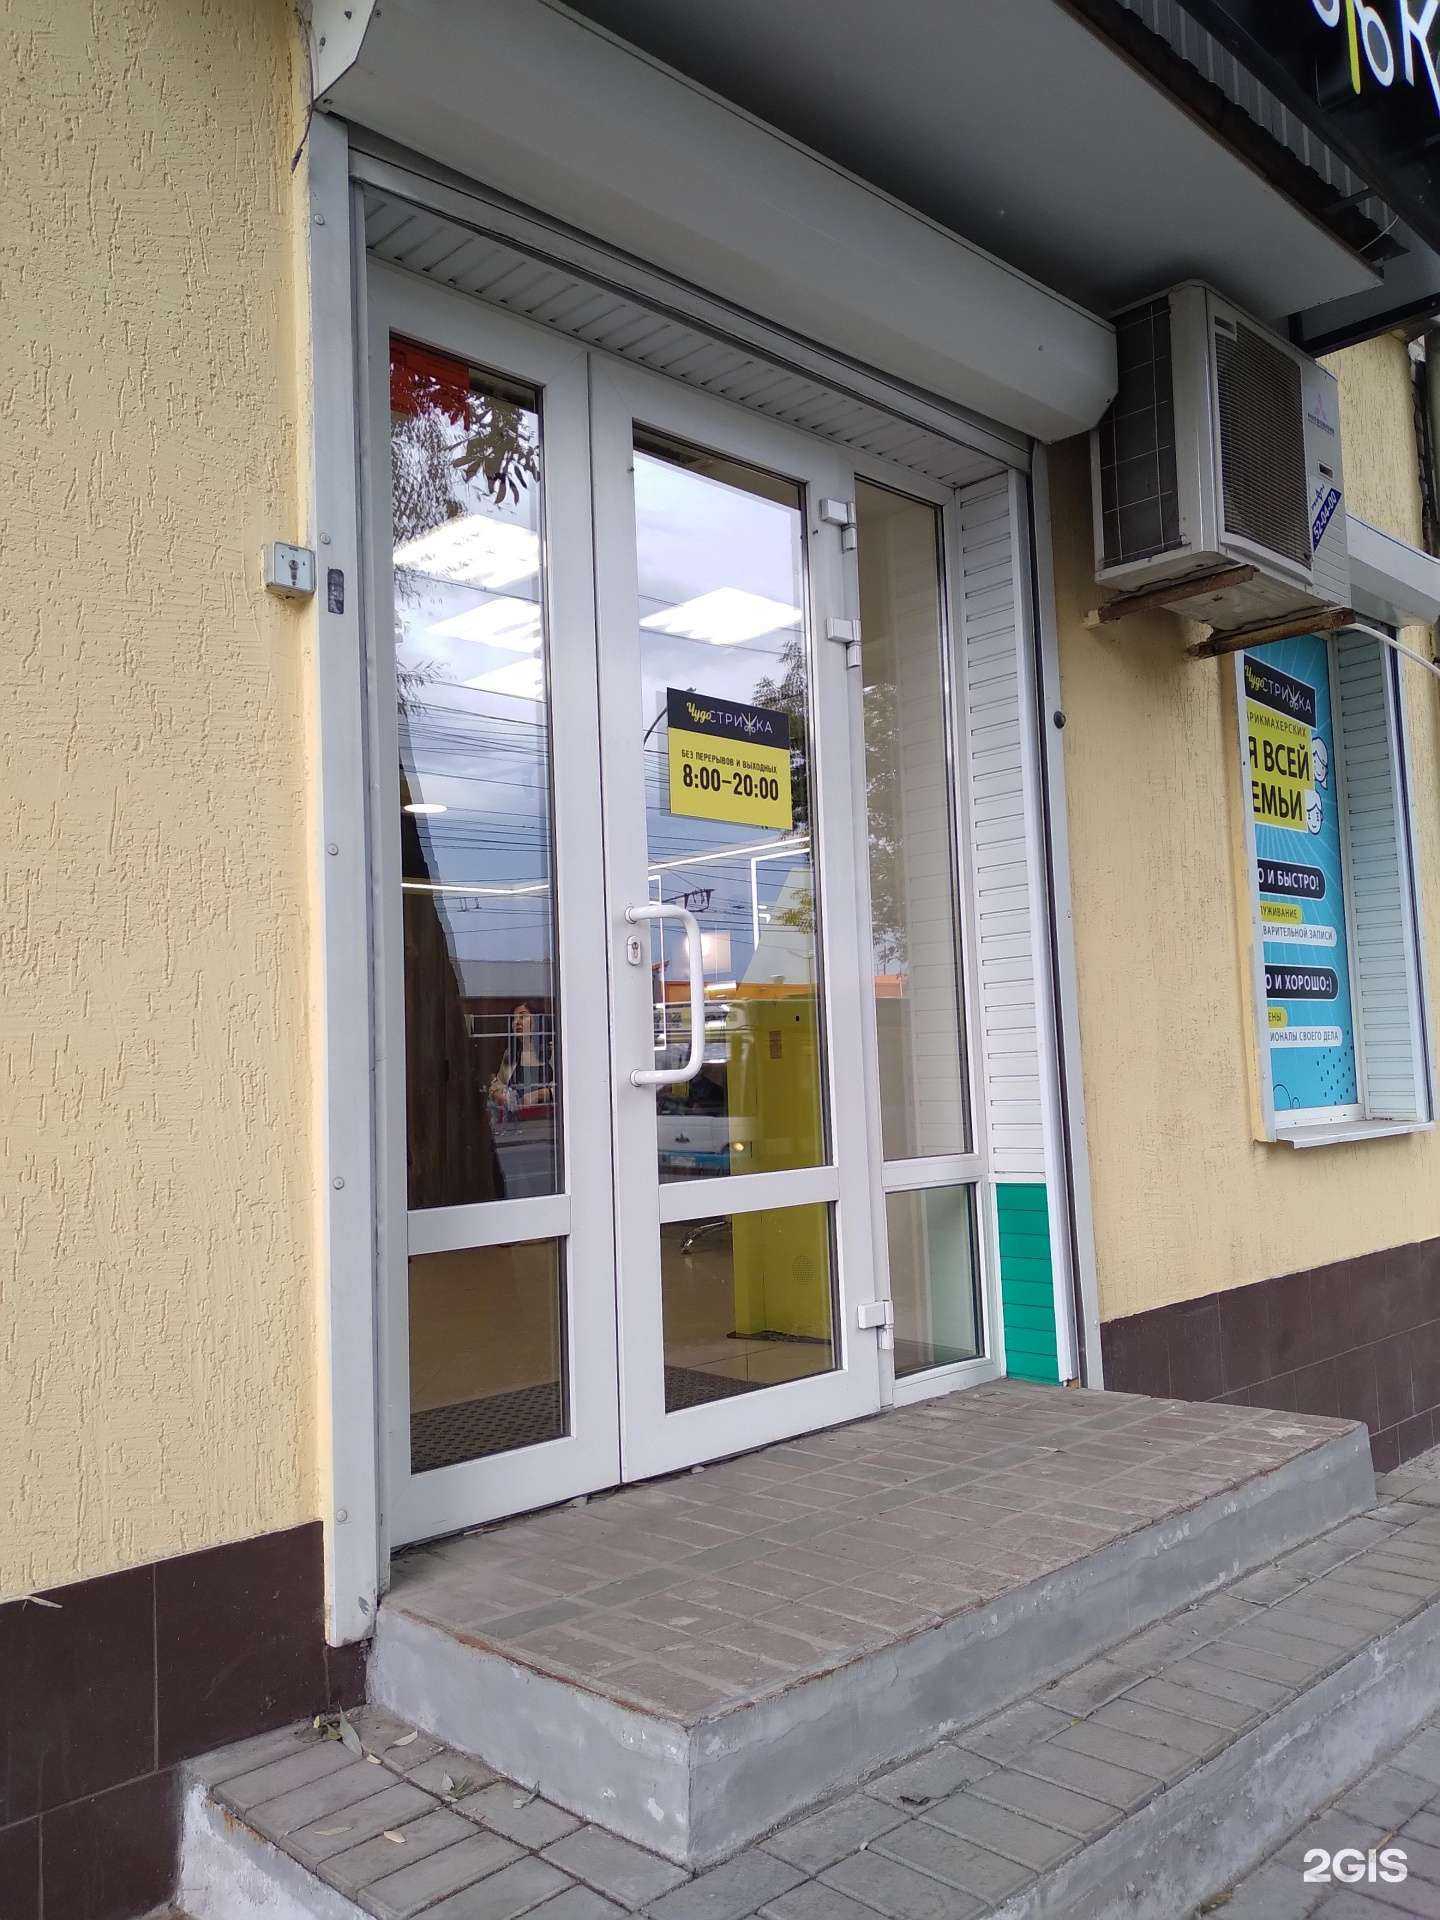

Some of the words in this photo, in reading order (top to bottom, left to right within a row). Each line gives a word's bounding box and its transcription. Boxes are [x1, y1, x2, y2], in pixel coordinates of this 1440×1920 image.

[1314, 491, 1337, 540] 52-04-00
[682, 749, 694, 760] БЕЗ
[696, 752, 734, 766] ПЕРЕРЫВОВ
[737, 759, 741, 767] И
[743, 760, 777, 774] ВЫХОДНЫХ
[1263, 740, 1310, 781] ВСЕЙ
[1252, 781, 1303, 821] ЕМЬИ
[1267, 869, 1275, 885] И
[1277, 870, 1320, 890] БЫСТРО!
[1309, 929, 1333, 941] ЗАПИСИ
[1274, 974, 1282, 990] И
[1285, 974, 1333, 993] ХОРОШО:)
[1299, 1031, 1322, 1041] СВОЕГО
[1323, 1031, 1339, 1042] ДЕЛА
